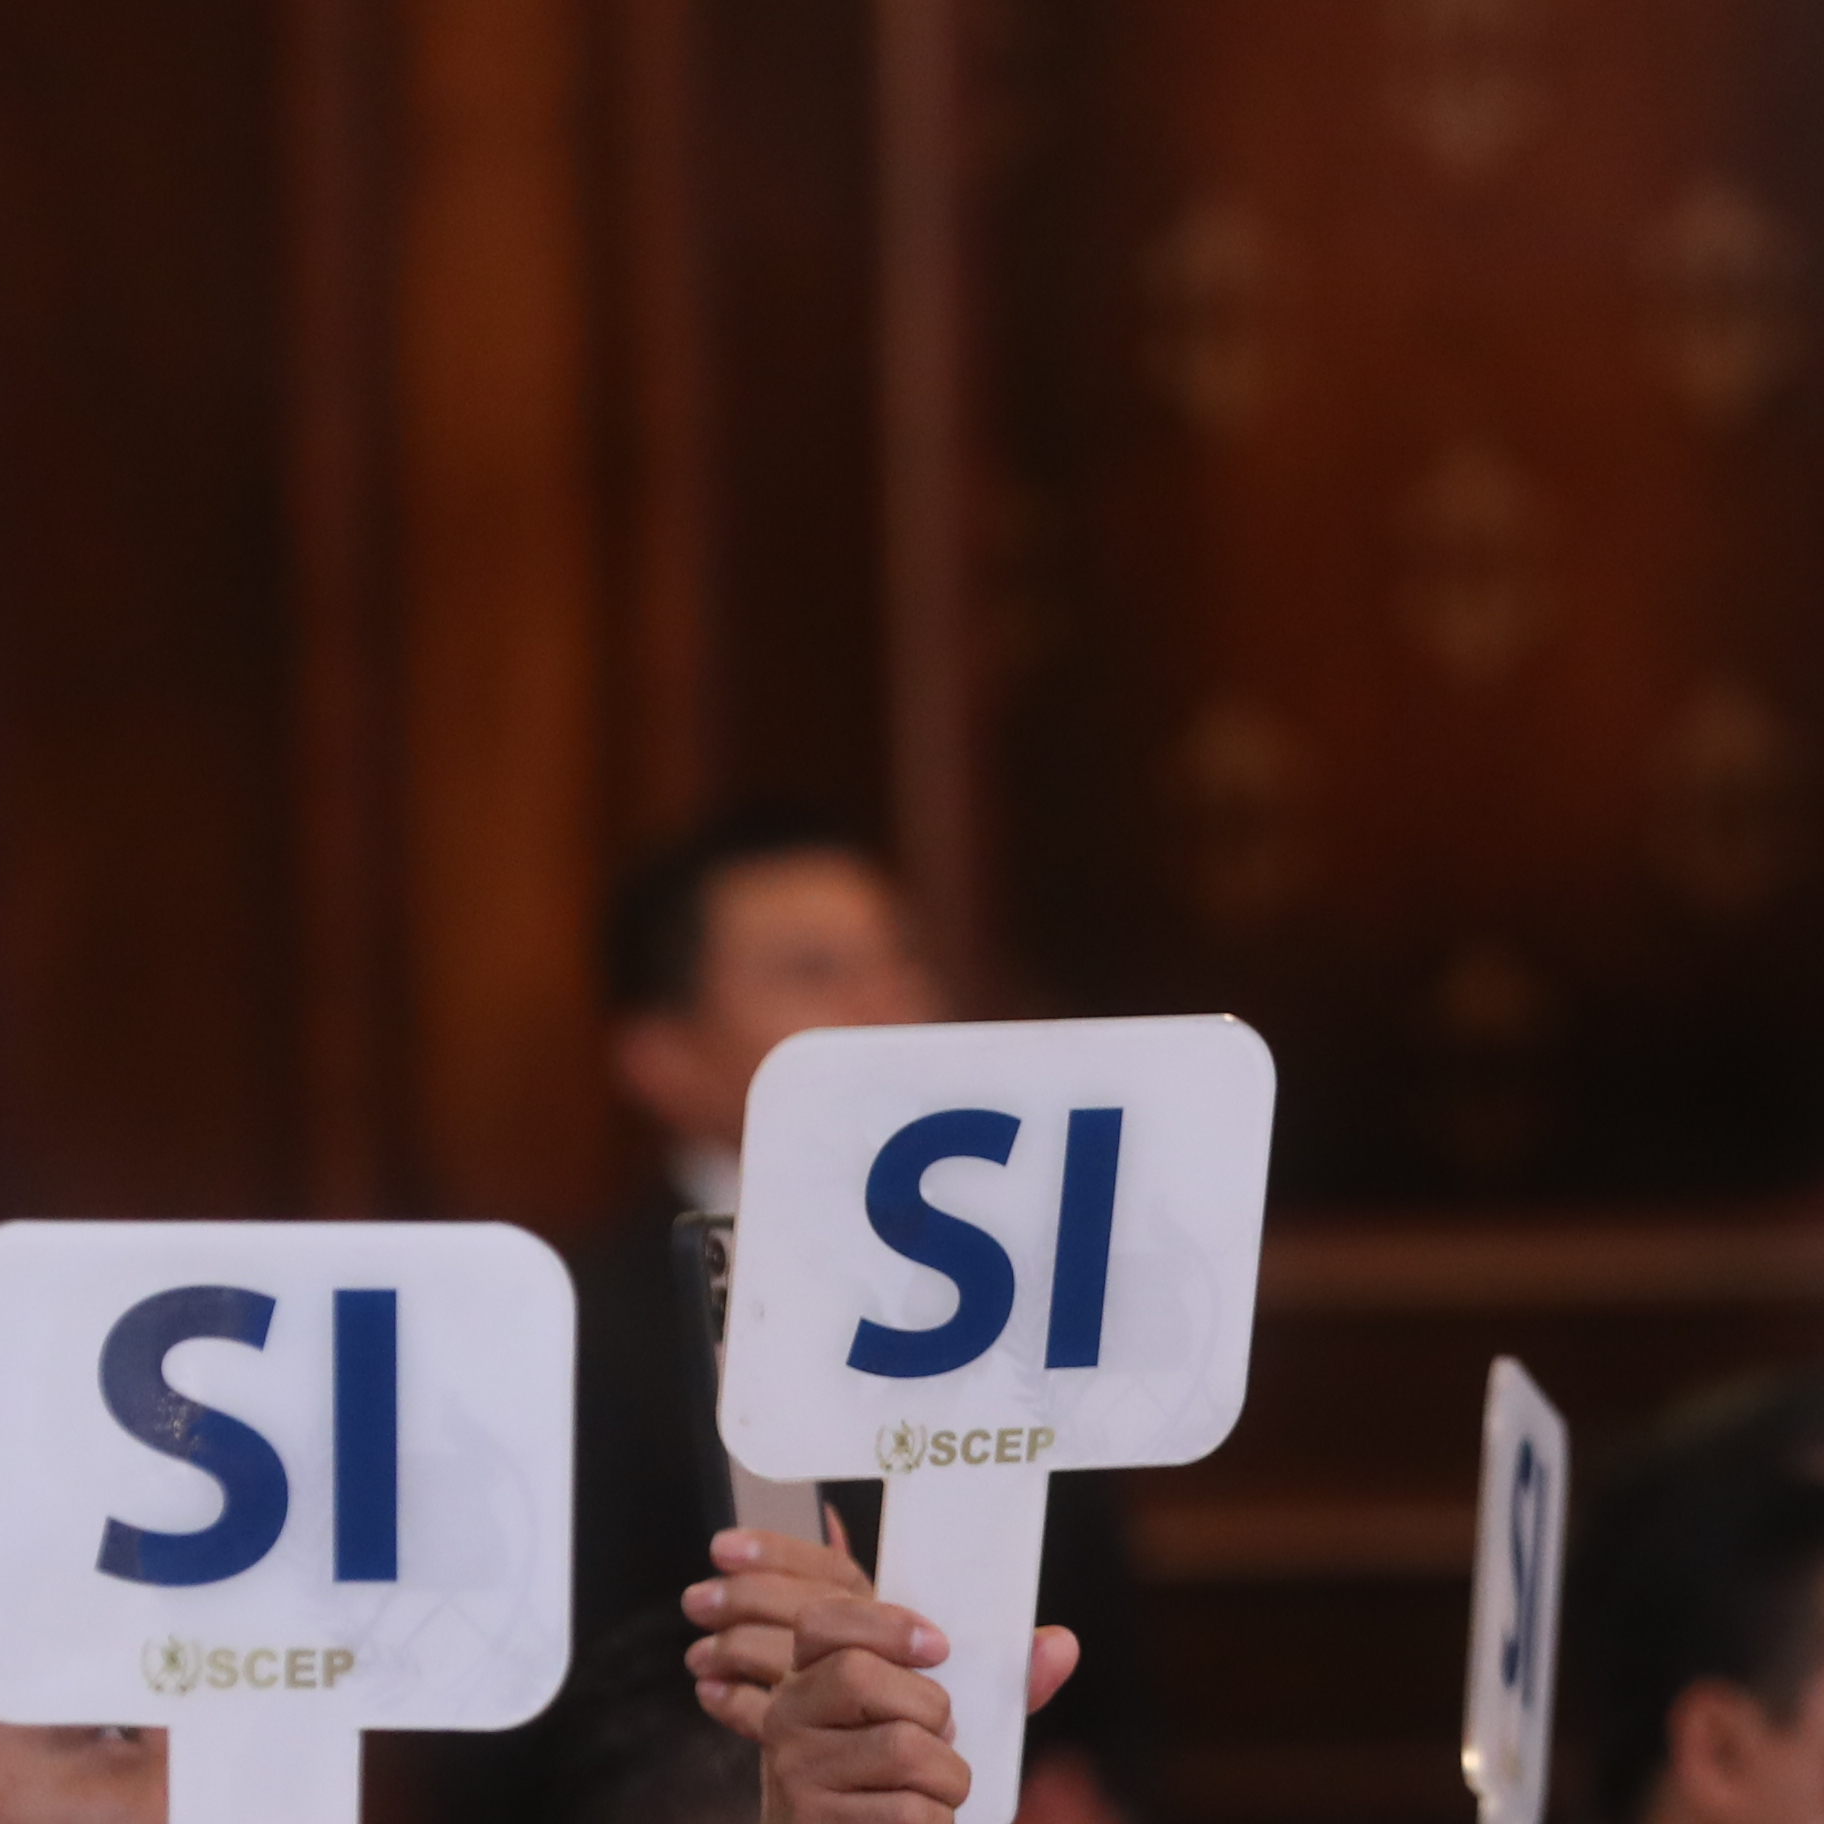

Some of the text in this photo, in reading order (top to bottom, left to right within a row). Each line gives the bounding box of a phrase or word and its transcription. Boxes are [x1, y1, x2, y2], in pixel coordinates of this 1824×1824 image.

[847, 1106, 1124, 1380] SI
[95, 1284, 398, 1588] SI
[929, 1427, 1056, 1467] SCEP
[1501, 1433, 1550, 1709] SI
[205, 1646, 356, 1690] SCEP
